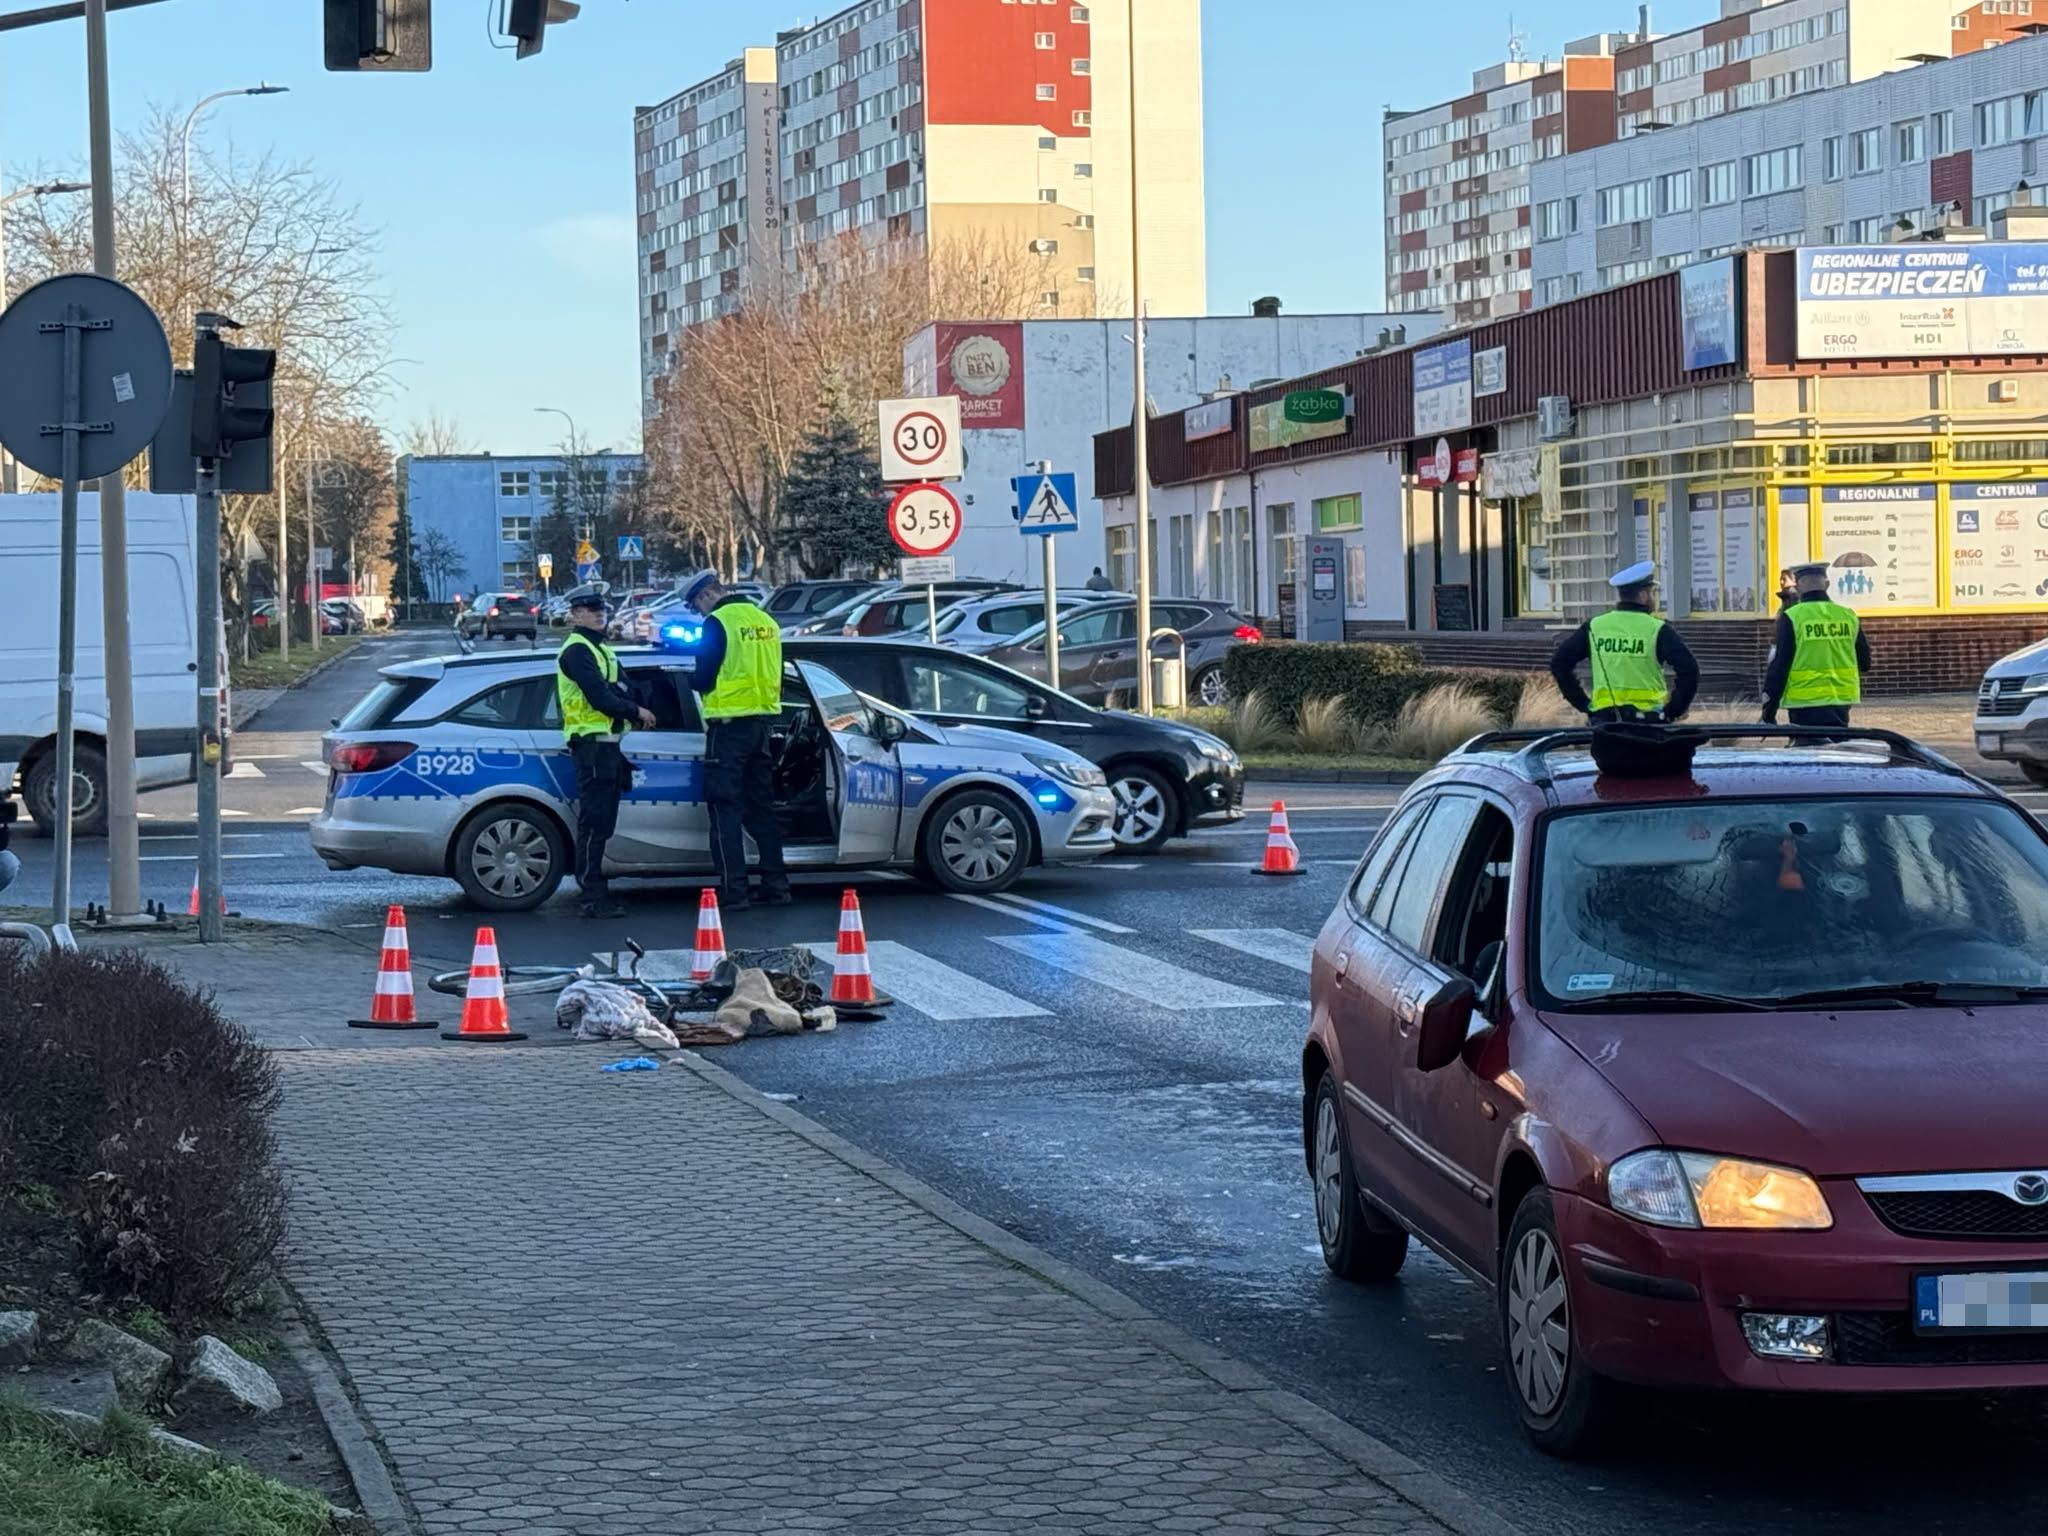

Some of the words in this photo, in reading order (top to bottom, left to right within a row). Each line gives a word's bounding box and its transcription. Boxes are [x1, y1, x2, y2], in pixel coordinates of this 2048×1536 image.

[1812, 254, 1899, 268] REGIONALNE
[1904, 252, 1969, 267] CENTRUM
[1810, 263, 1987, 295] UBEZPIECZEŃ
[1824, 334, 1858, 346] ERGO
[1914, 333, 1942, 345] HDI
[967, 360, 996, 376] BEN
[960, 399, 1002, 411] MARKET
[1292, 396, 1339, 410] żabka
[902, 425, 940, 451] 30
[1839, 487, 1920, 501] REGIONALNE
[1976, 484, 2037, 497] CENTRUM
[901, 504, 950, 535] 3,5t
[1954, 549, 1983, 559] ERGO
[1955, 584, 1984, 597] HDI
[1805, 623, 1850, 638] POLCJA
[1597, 637, 1645, 654] POLICJA
[417, 754, 475, 776] B928
[856, 769, 895, 802] POLICJA
[1921, 1309, 1936, 1320] PL
